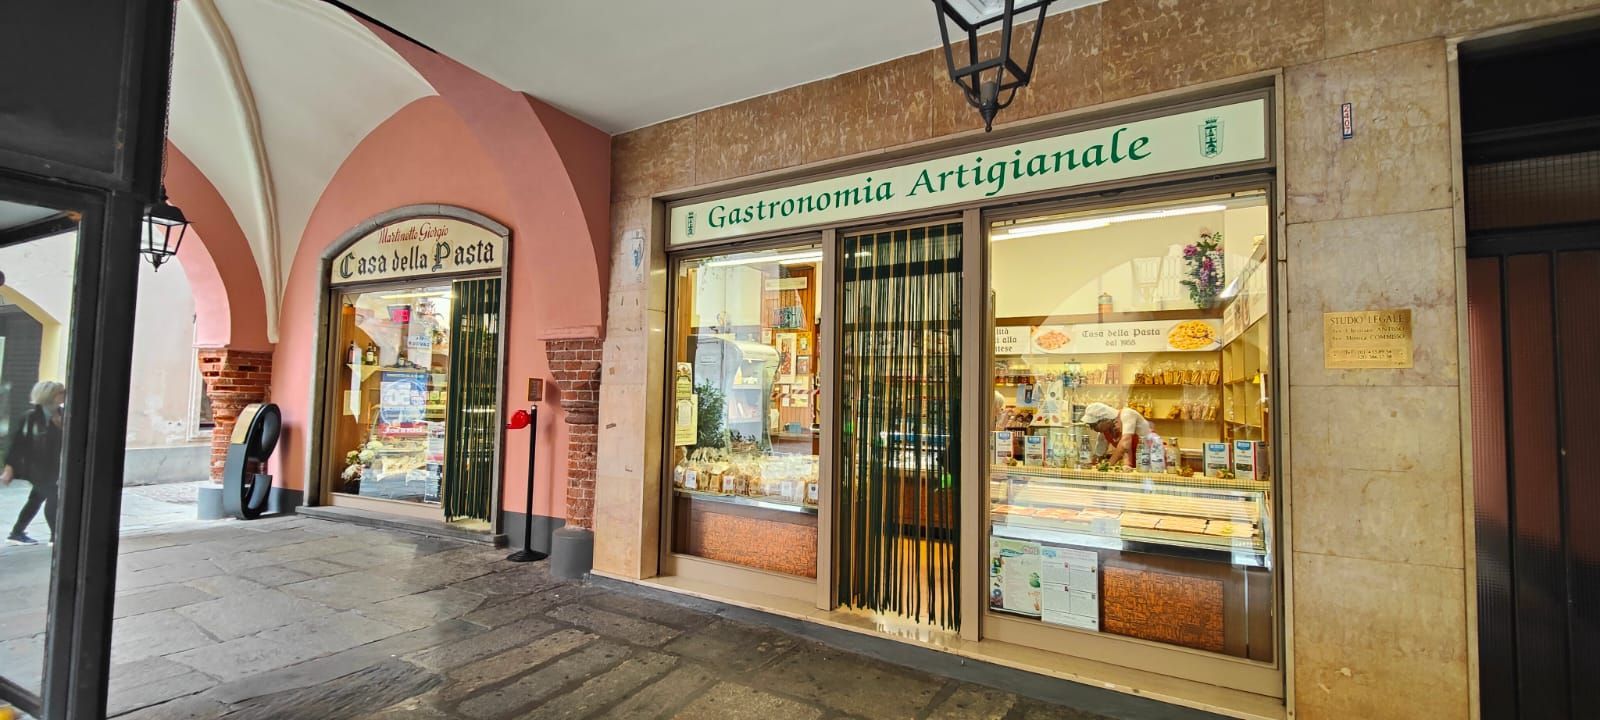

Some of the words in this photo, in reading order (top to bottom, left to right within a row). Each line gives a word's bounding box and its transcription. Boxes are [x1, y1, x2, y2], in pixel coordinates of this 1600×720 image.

[708, 176, 895, 228] Gastronomia
[906, 127, 1151, 197] Artigianale
[419, 222, 449, 242] Giorgio
[339, 251, 387, 279] Casa
[392, 245, 428, 273] della
[432, 239, 494, 273] Pasta
[1329, 316, 1364, 325] STUDIO
[1368, 314, 1403, 324] LEGALE
[1081, 330, 1105, 338] Casa
[1107, 328, 1129, 337] della
[1133, 327, 1161, 338] Pasta
